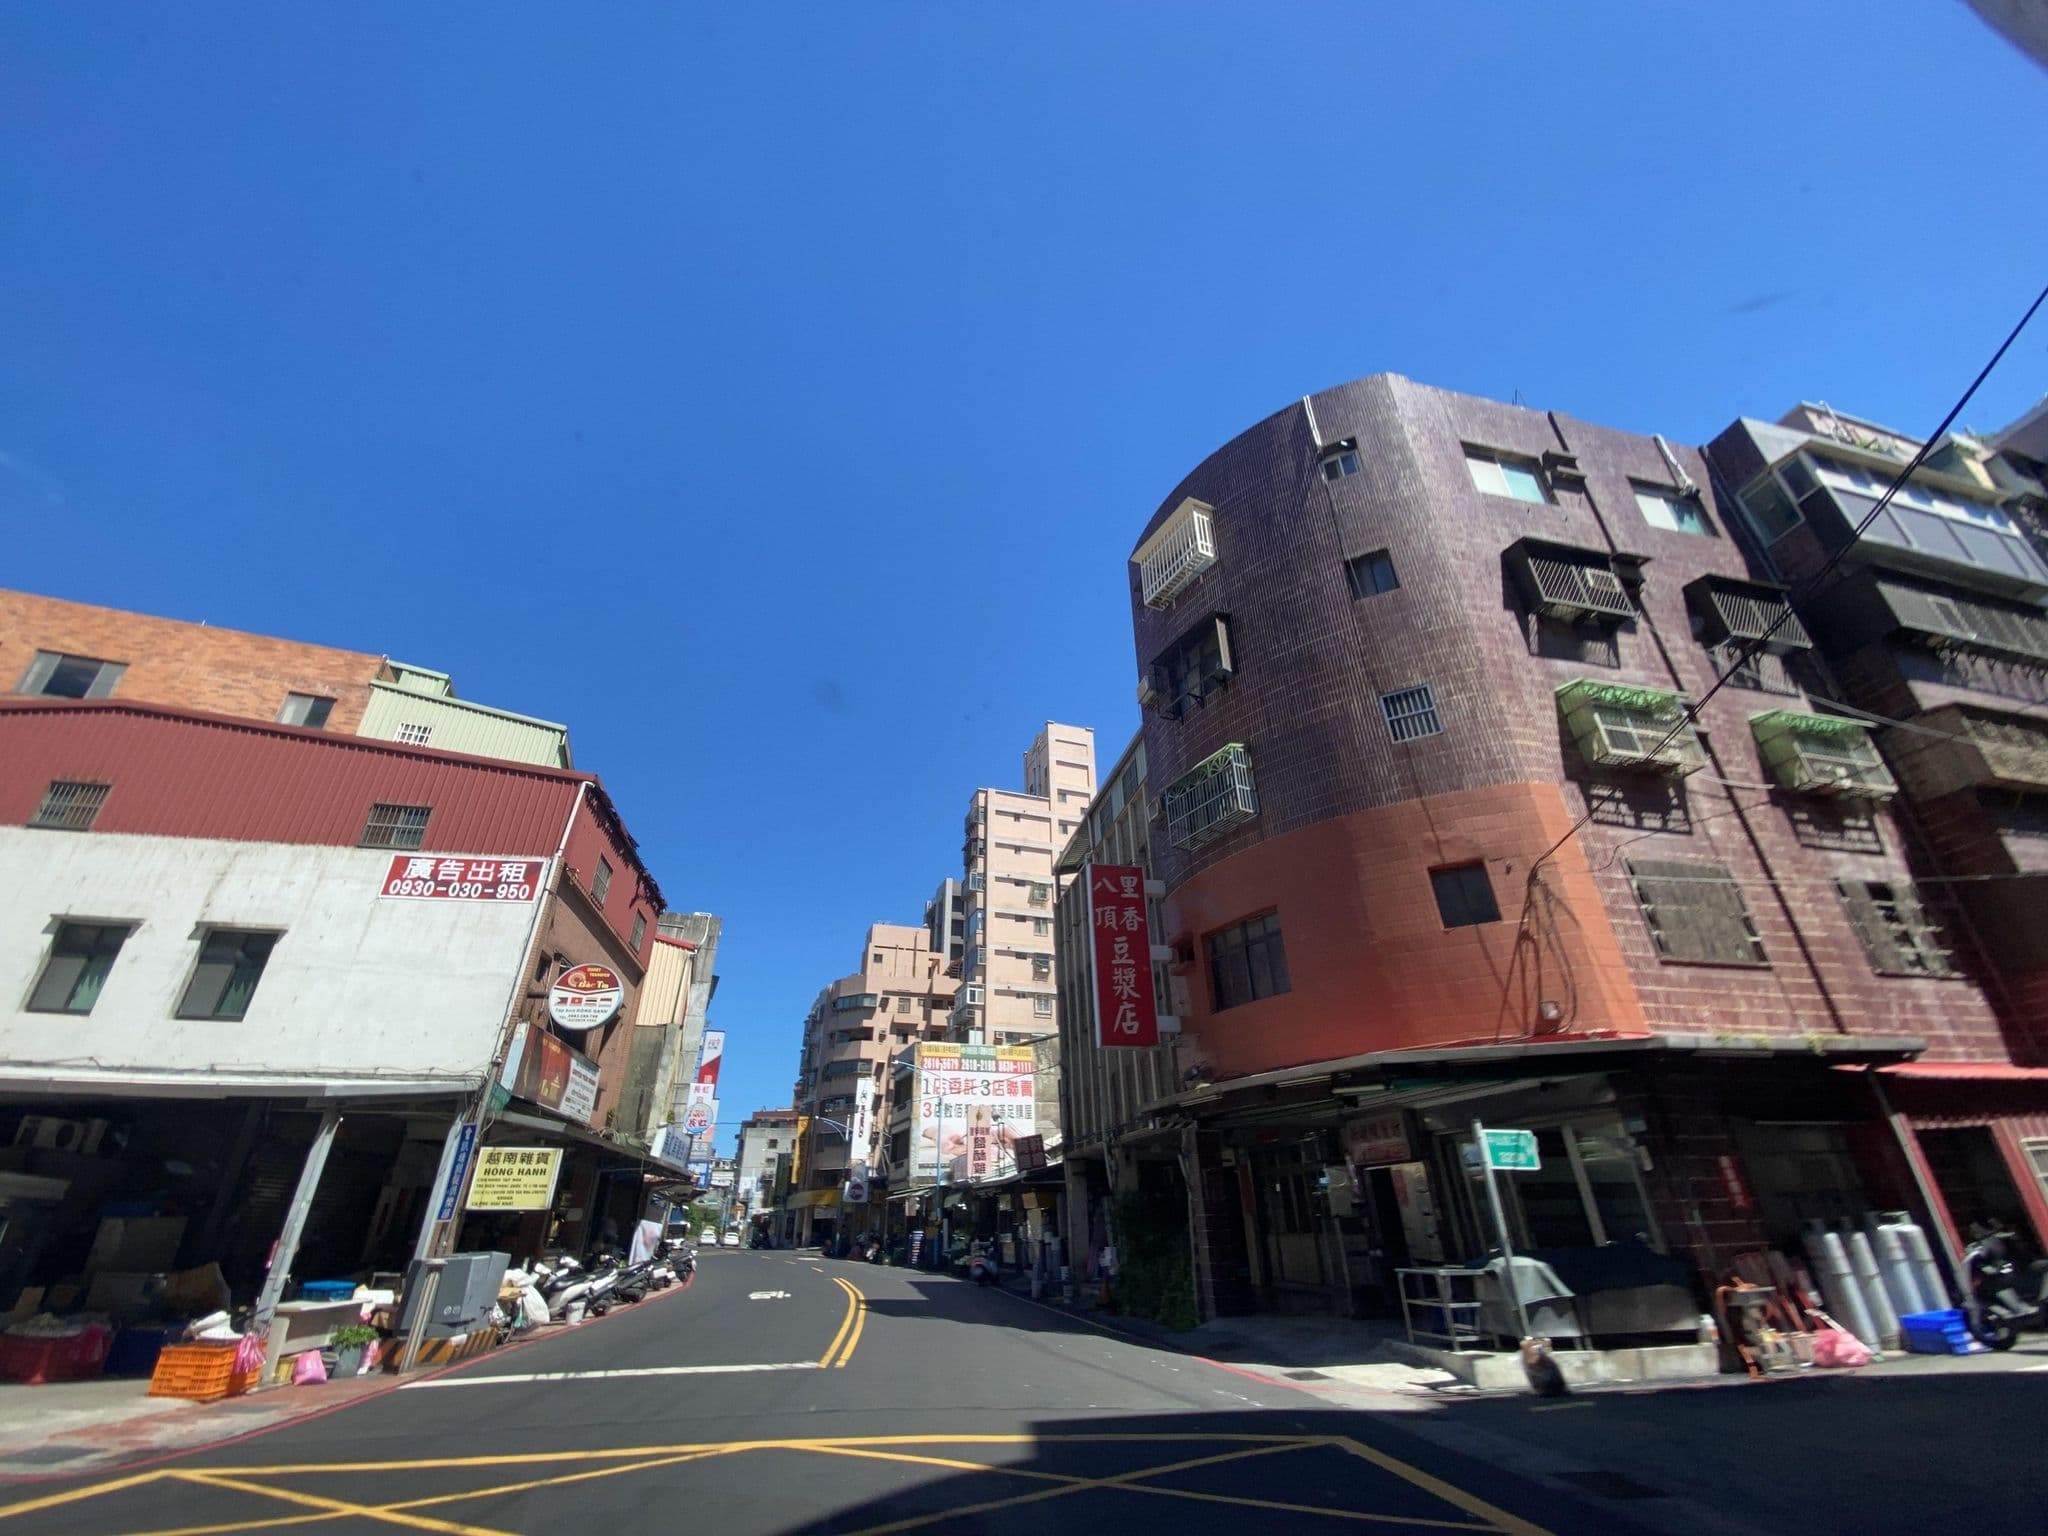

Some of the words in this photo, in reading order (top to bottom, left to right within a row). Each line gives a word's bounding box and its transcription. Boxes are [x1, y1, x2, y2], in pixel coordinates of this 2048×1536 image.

[402, 858, 527, 883] 廣告出租
[389, 879, 529, 899] 0930-030-950
[485, 1152, 551, 1165] 越南雜貨
[483, 1168, 514, 1176] HONG
[517, 1168, 547, 1176] HANH
